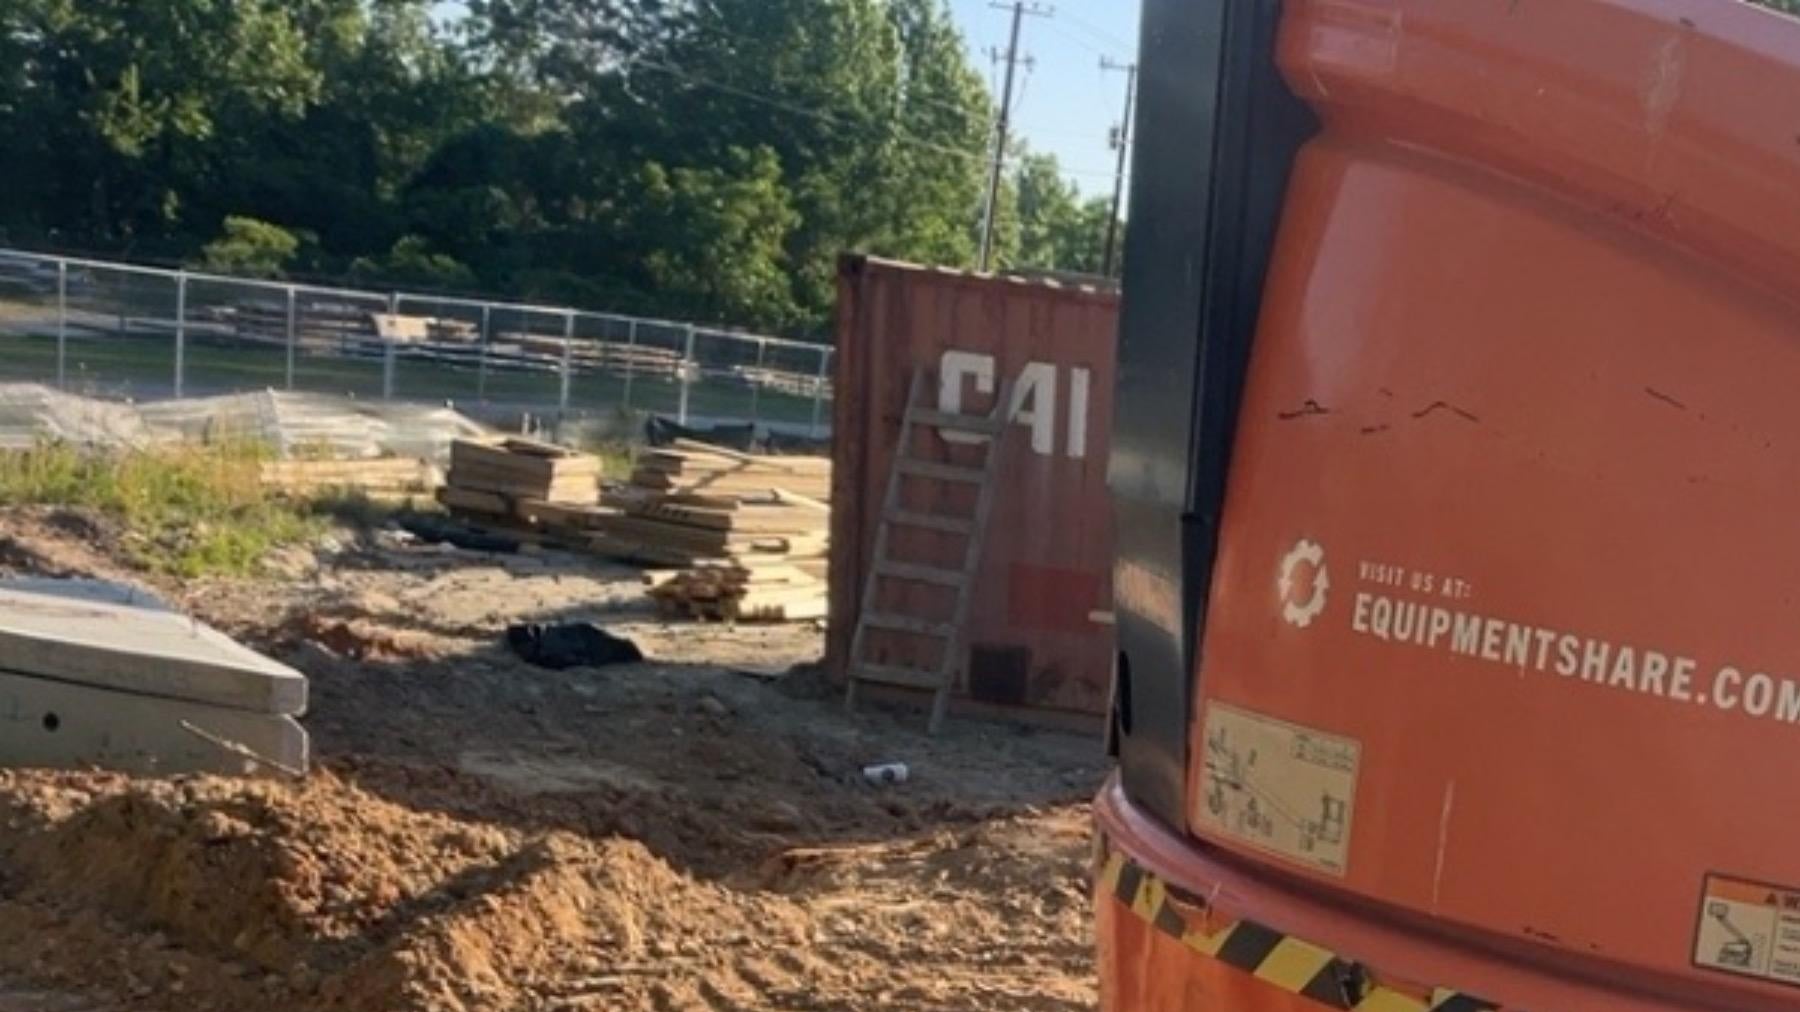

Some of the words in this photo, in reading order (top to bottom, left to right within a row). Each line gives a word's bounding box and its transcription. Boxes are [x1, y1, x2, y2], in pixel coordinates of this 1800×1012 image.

[1358, 560, 1405, 588] VISIT
[1412, 571, 1434, 593] US
[1441, 576, 1472, 598] AT:
